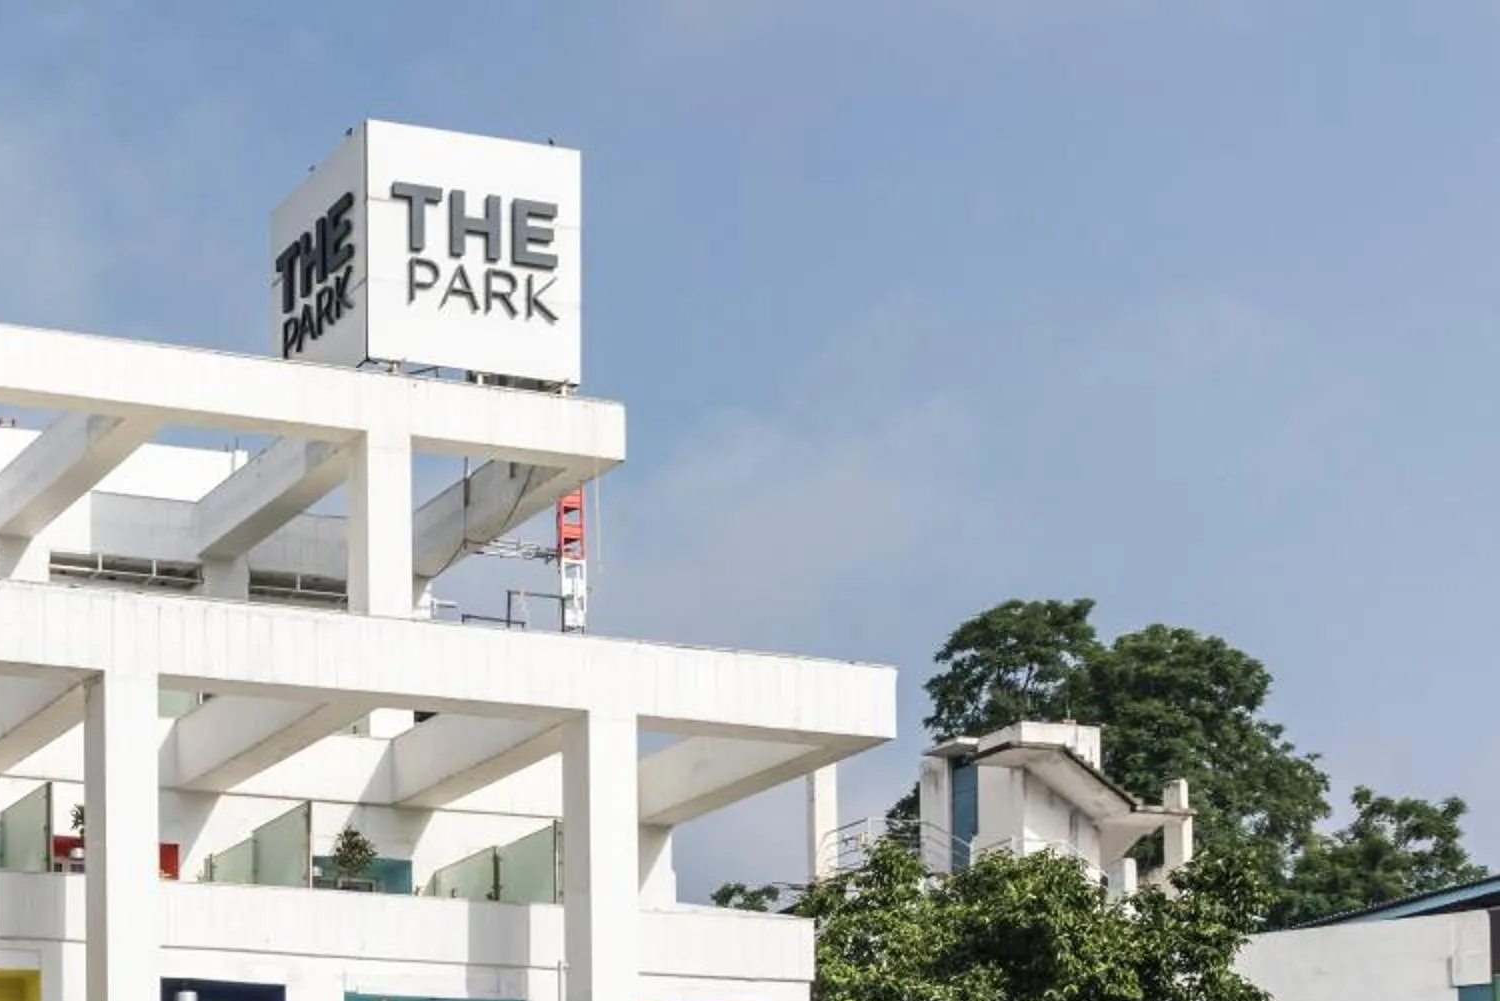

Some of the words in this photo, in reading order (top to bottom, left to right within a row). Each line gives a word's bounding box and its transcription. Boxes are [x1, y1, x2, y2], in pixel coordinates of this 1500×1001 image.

[275, 191, 355, 314] THE
[391, 181, 559, 271] THE
[282, 264, 355, 359] PARK
[406, 256, 560, 325] PARK
